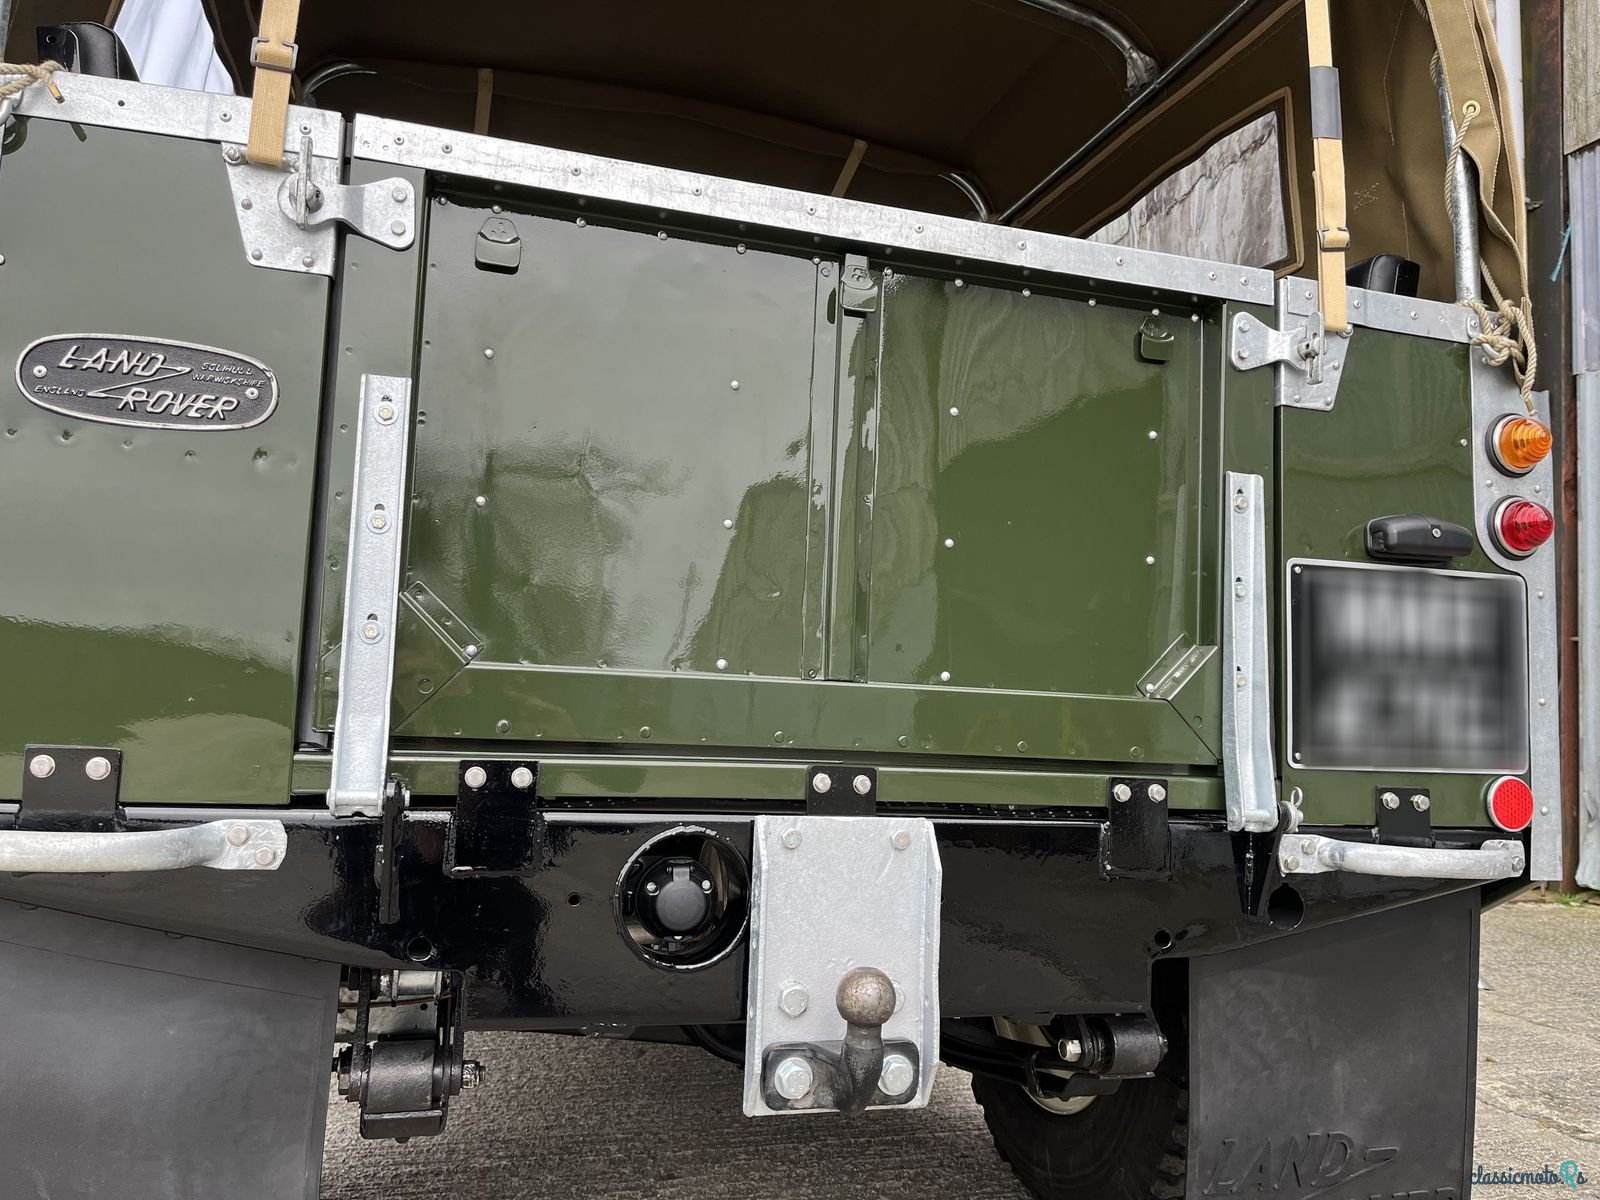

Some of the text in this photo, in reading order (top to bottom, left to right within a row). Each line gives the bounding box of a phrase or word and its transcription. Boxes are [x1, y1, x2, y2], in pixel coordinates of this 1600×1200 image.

[57, 345, 166, 377] LAND
[201, 362, 253, 376] SOLIHULL
[34, 384, 85, 397] ENGLAND
[192, 373, 265, 388] WARWICKSHIRE
[117, 387, 239, 420] ROVER
[1202, 1131, 1355, 1195] LAND
